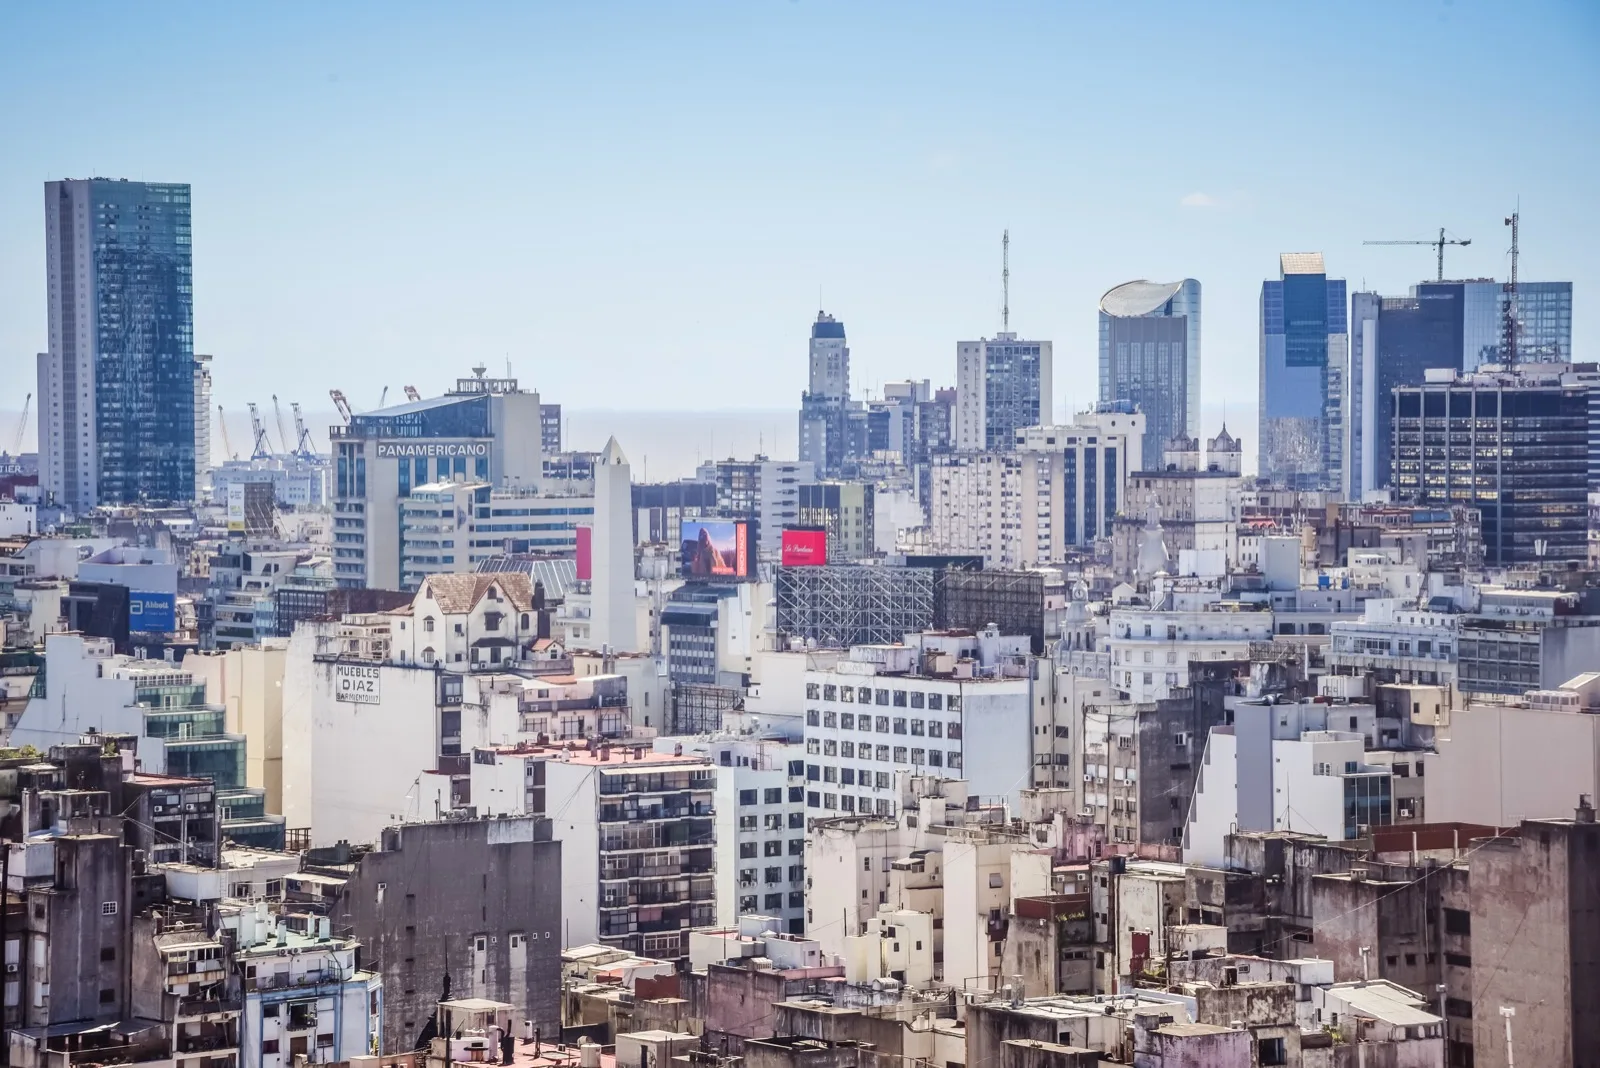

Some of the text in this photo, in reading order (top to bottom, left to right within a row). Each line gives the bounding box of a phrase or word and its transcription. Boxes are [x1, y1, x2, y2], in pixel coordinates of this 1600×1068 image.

[378, 444, 486, 456] PANAMERICANO
[144, 600, 169, 609] Abbott
[337, 666, 379, 679] MUEBLES
[342, 679, 374, 692] DIAZ
[336, 692, 369, 702] SARMIENTO
